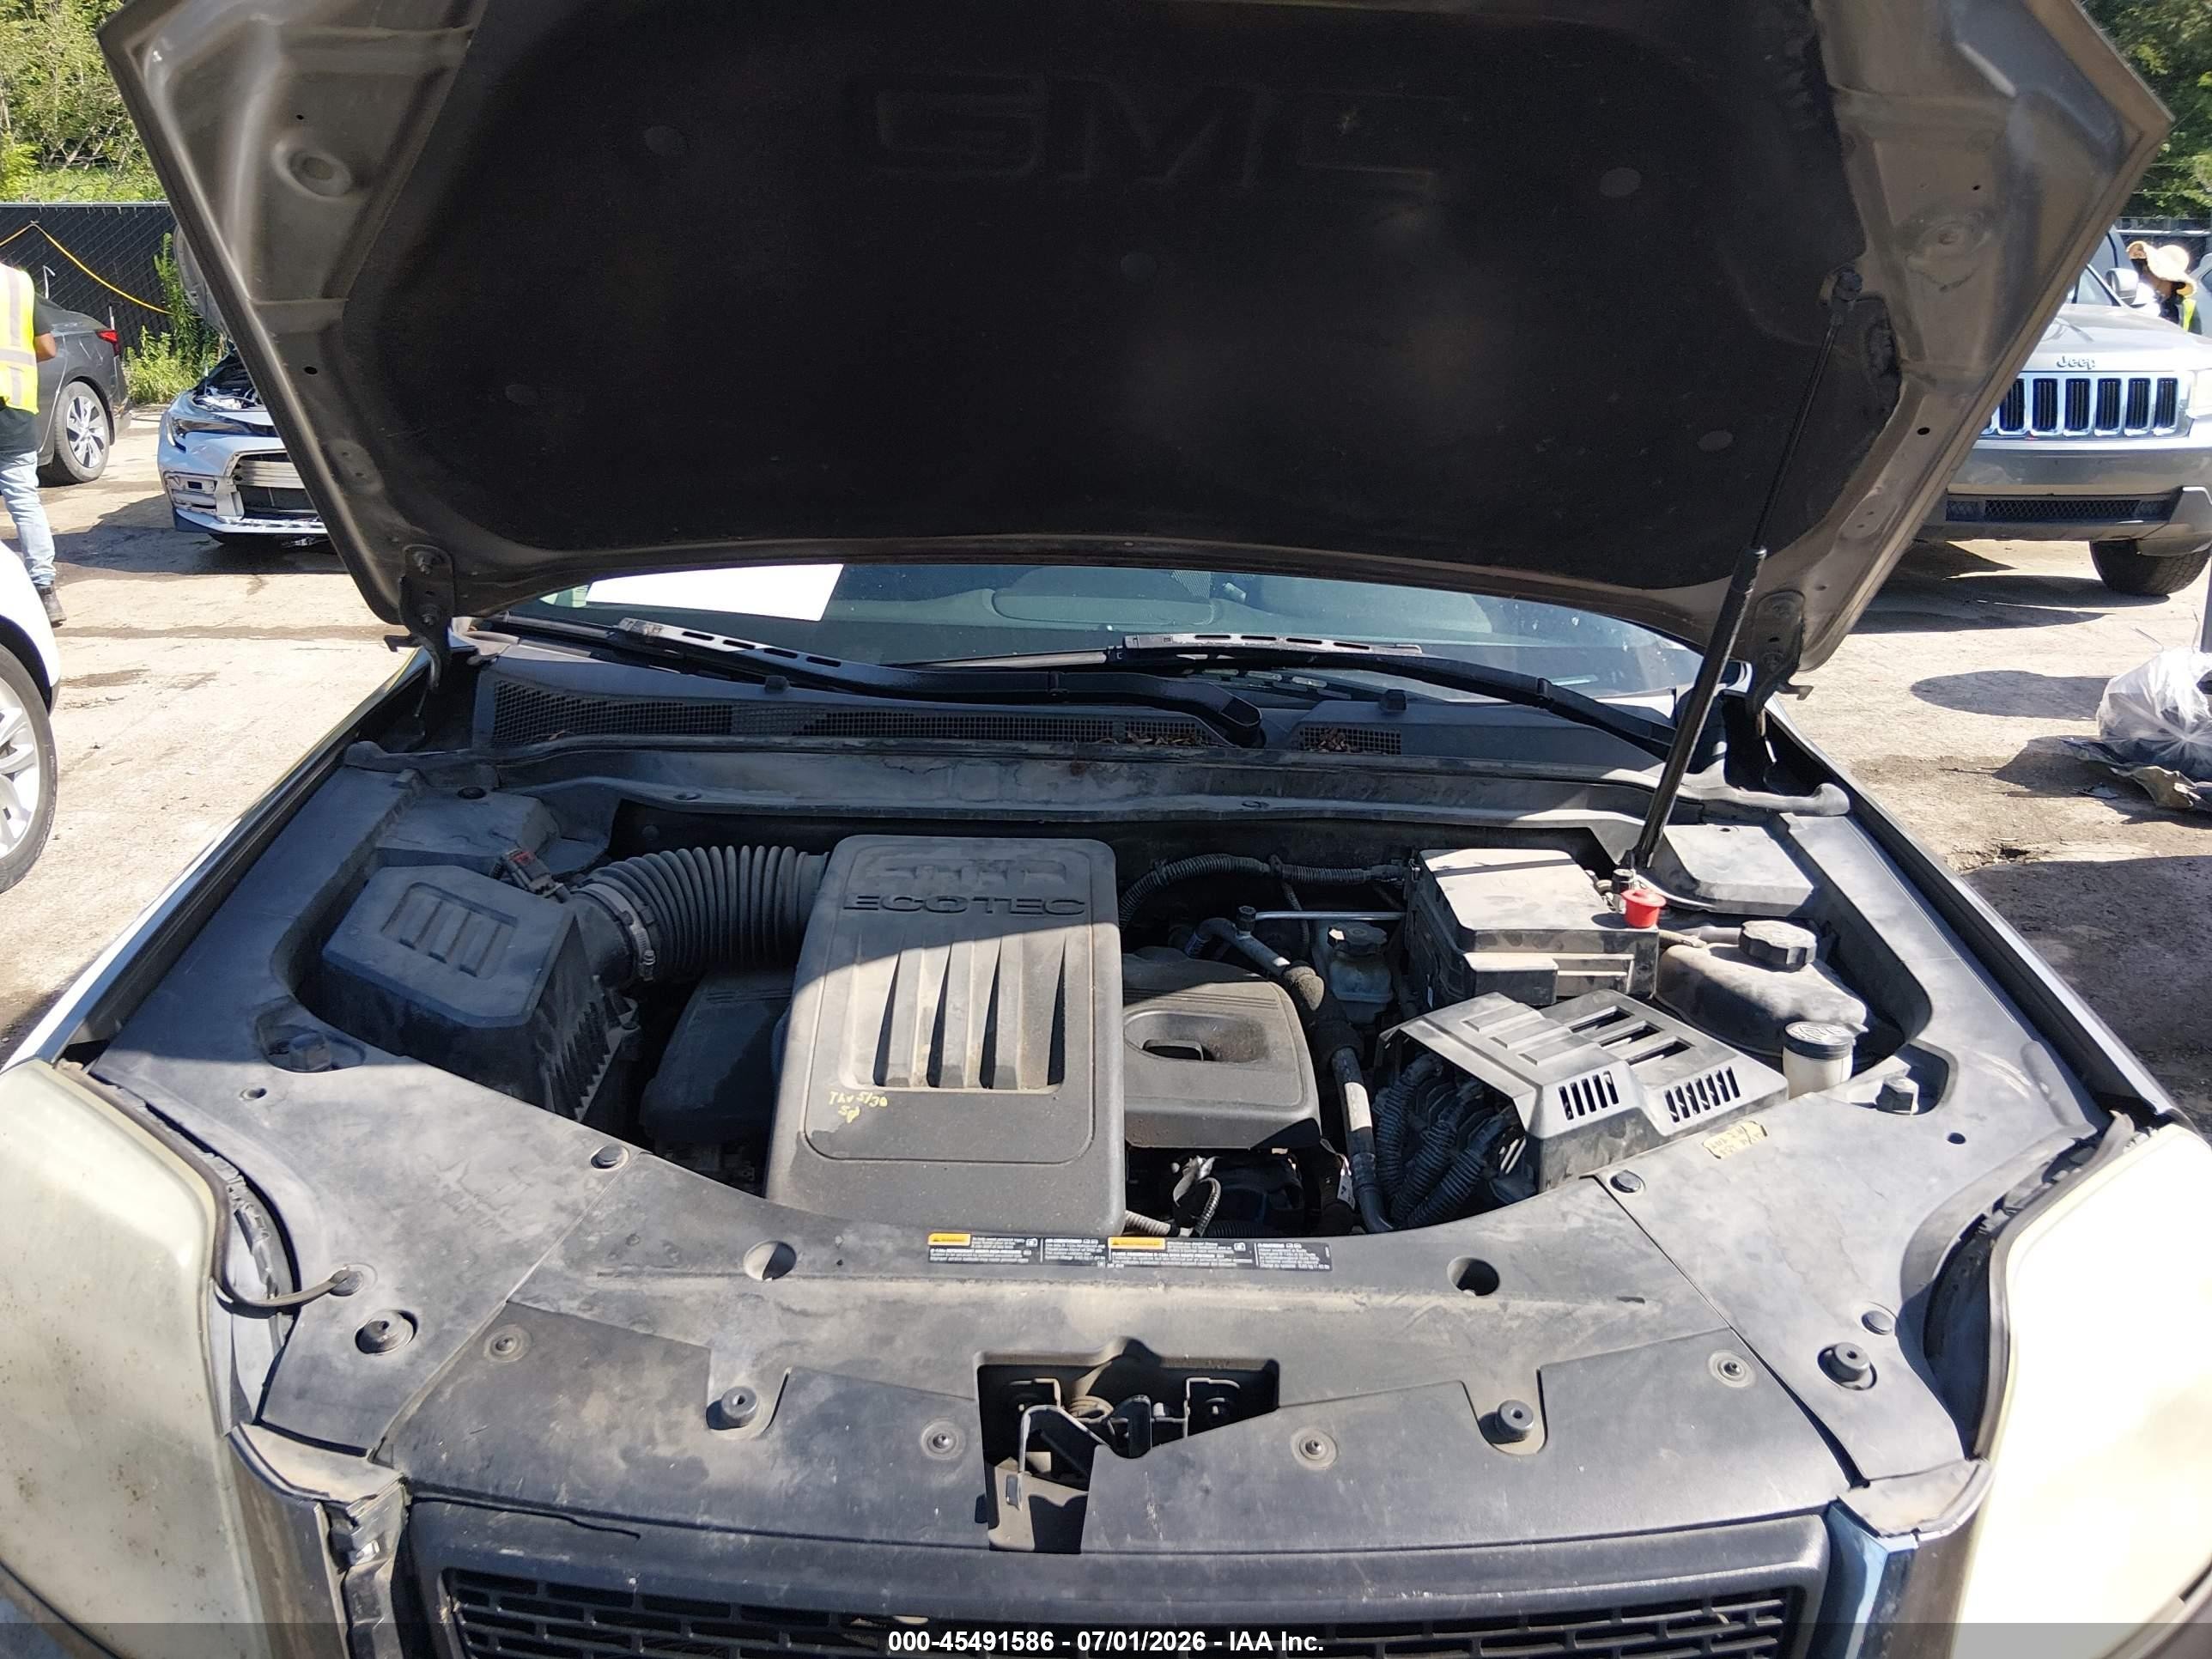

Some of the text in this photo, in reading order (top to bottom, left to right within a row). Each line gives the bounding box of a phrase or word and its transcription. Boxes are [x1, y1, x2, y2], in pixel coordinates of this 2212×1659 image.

[843, 72, 1451, 191] GMC
[2056, 354, 2096, 370] Jeep
[843, 895, 1086, 916] ECOTEC
